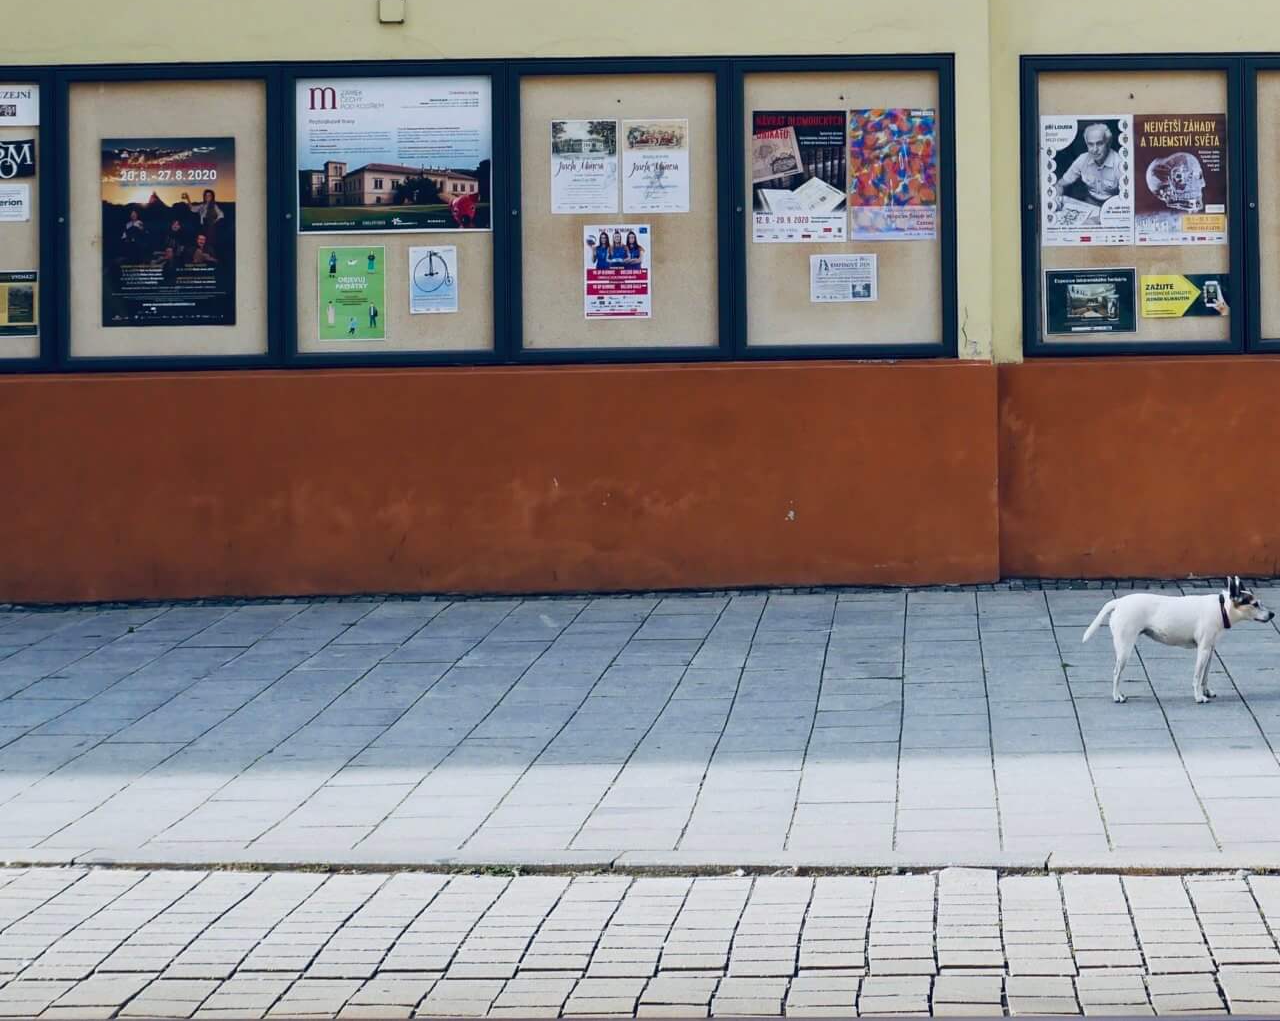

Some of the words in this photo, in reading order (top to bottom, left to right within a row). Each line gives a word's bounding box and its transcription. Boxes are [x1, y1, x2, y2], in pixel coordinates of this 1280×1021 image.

[1144, 119, 1181, 133] NEJVĚTŠÍ
[1183, 119, 1216, 132] ZÁHADY
[1140, 136, 1147, 147] A
[1148, 133, 1192, 147] TAJEMSTVÍ
[1194, 133, 1220, 147] SVĚTA
[1145, 282, 1175, 291] ZAŽIJTE
